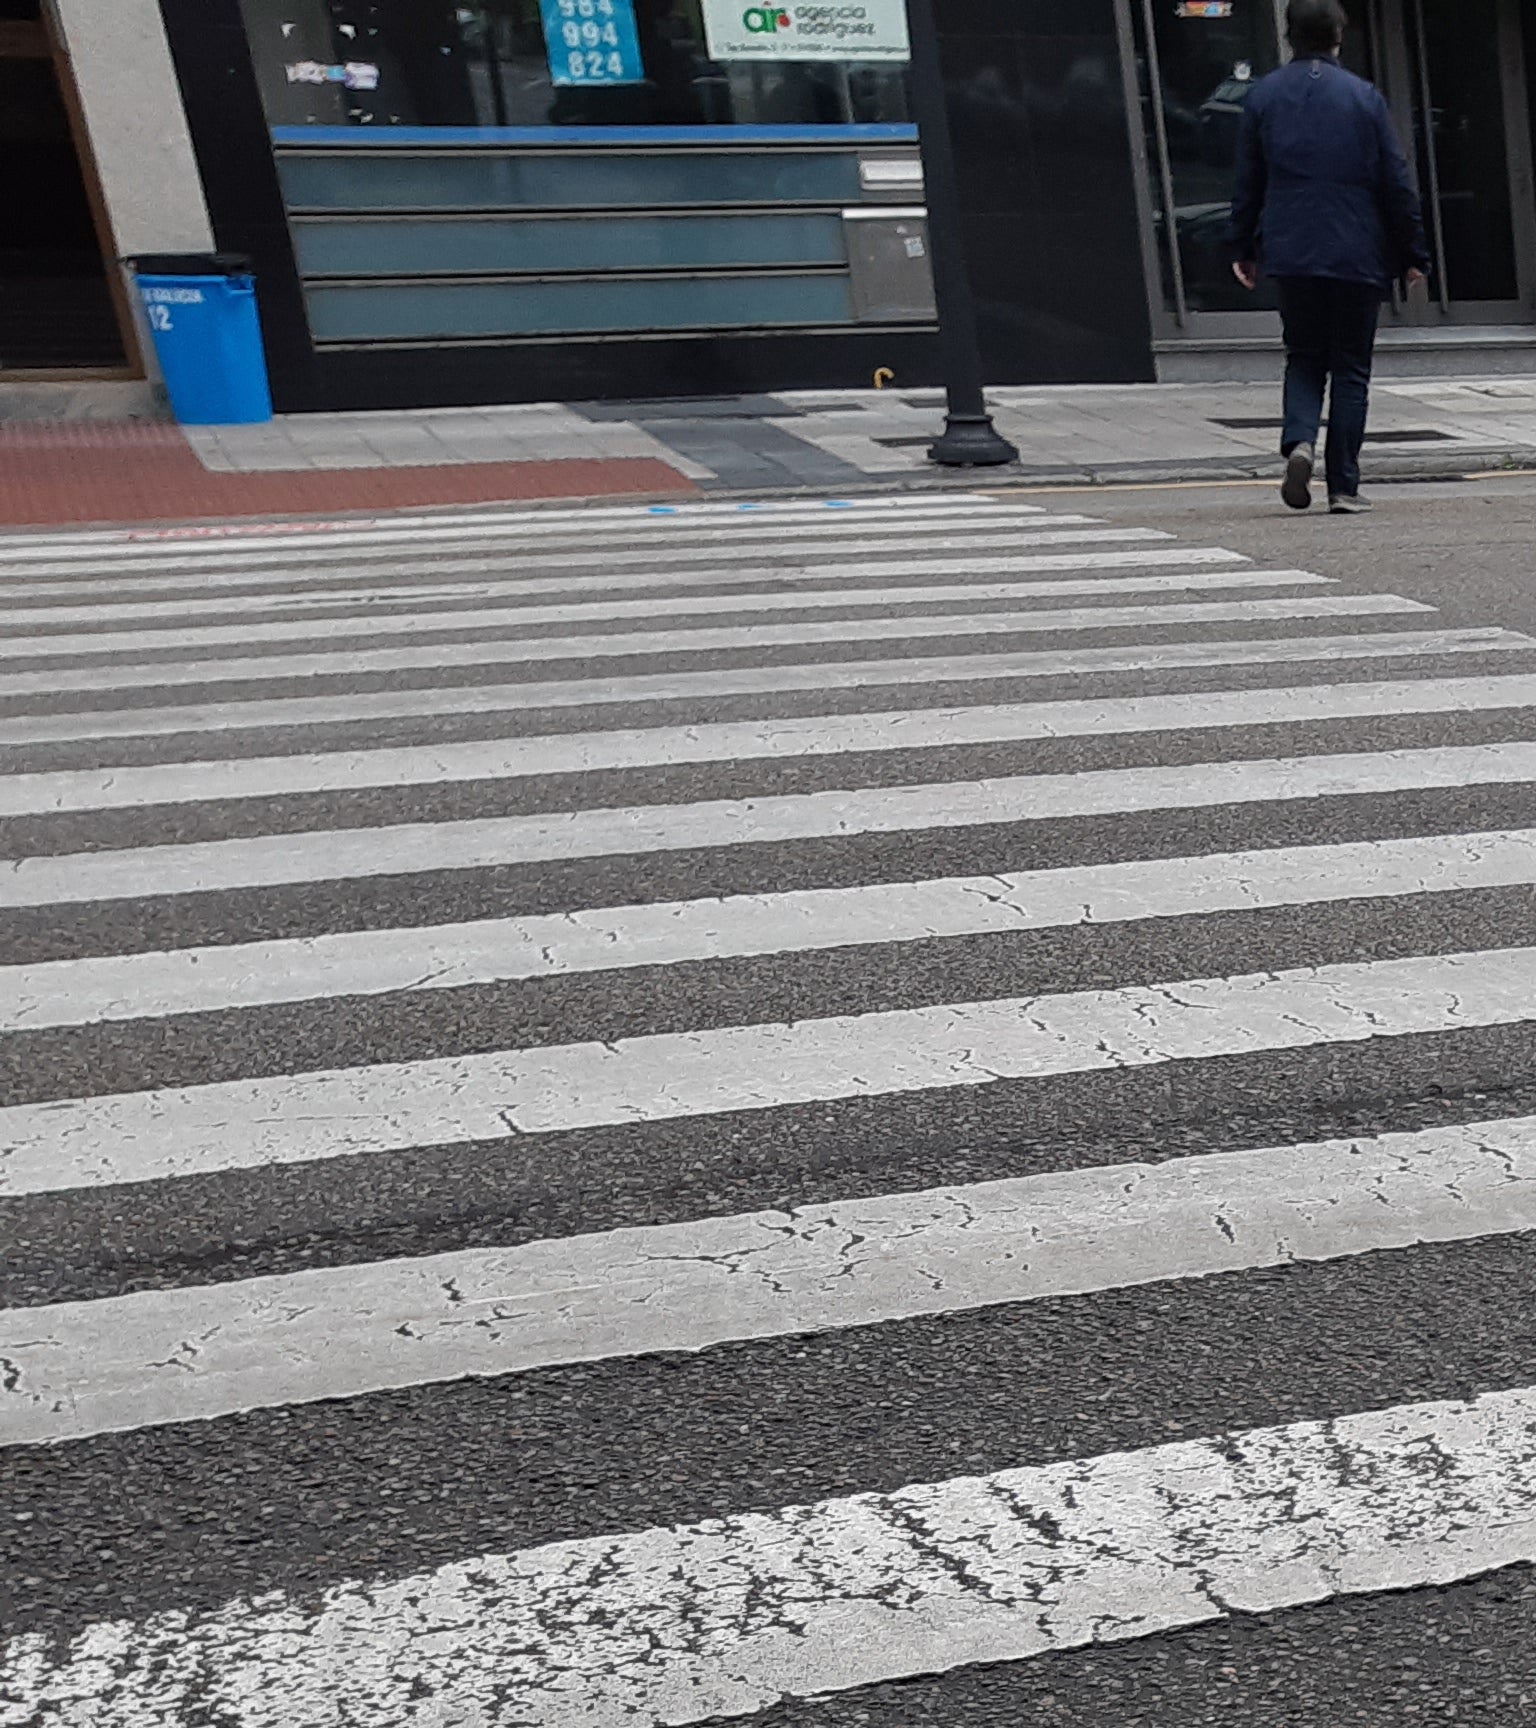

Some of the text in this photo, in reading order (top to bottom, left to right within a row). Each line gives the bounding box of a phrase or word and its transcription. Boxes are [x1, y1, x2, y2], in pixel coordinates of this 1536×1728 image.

[561, 21, 619, 48] 994
[567, 50, 624, 77] 824
[148, 304, 174, 331] 12
